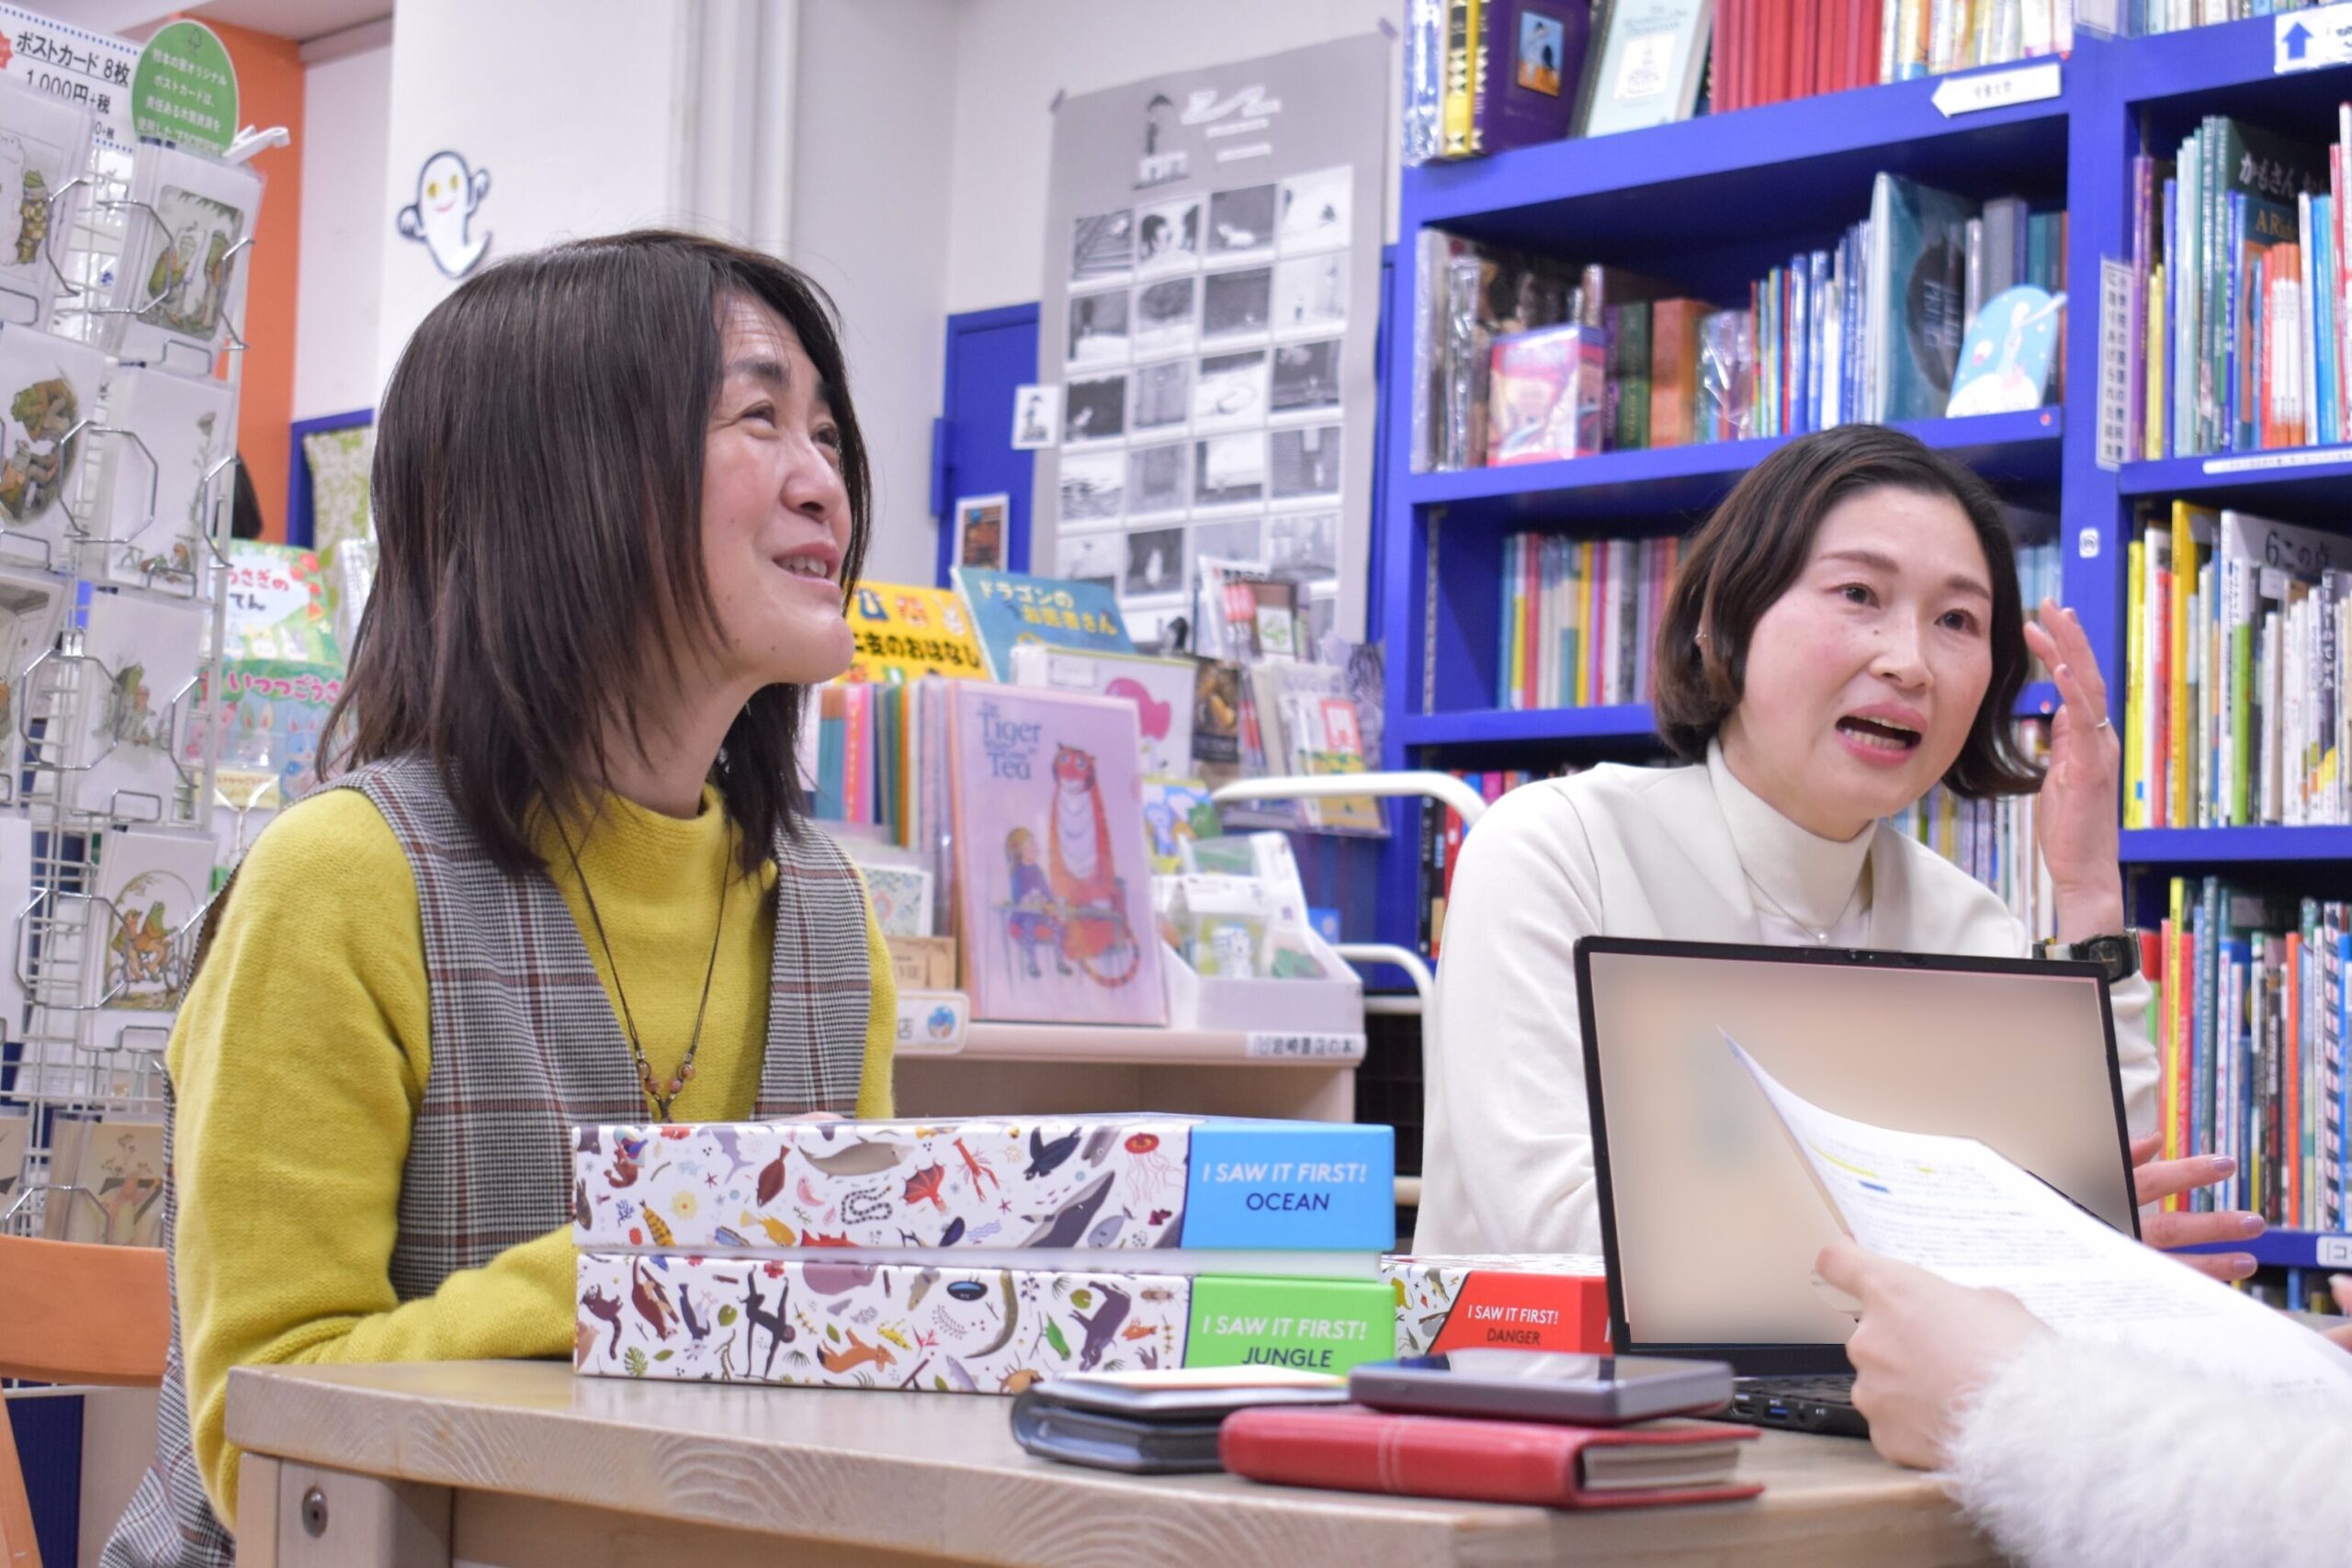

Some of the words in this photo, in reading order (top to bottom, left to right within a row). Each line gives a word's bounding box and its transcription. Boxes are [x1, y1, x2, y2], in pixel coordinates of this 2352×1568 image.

[16, 31, 99, 74] ポストカード
[103, 58, 131, 86] 8枚
[853, 632, 980, 669] 二支のおはなし
[228, 671, 341, 704] いつつごうさ
[977, 711, 1042, 749] Tiger
[987, 751, 1031, 780] Tea
[1201, 1164, 1211, 1183] I
[1215, 1163, 1268, 1183] SAW
[1272, 1163, 1294, 1182] IT
[1297, 1162, 1368, 1183] FIRST!
[1246, 1191, 1330, 1213] OCEAN
[1202, 1314, 1211, 1335] I
[1215, 1314, 1268, 1337] SAW
[1272, 1317, 1295, 1338] IT
[1297, 1317, 1368, 1341] FIRST!
[1475, 1305, 1503, 1321] SAW
[1506, 1306, 1518, 1322] IT
[1520, 1308, 1559, 1325] FIRST!
[1487, 1327, 1542, 1346] DANGER
[1241, 1346, 1334, 1369] JUNGLE
